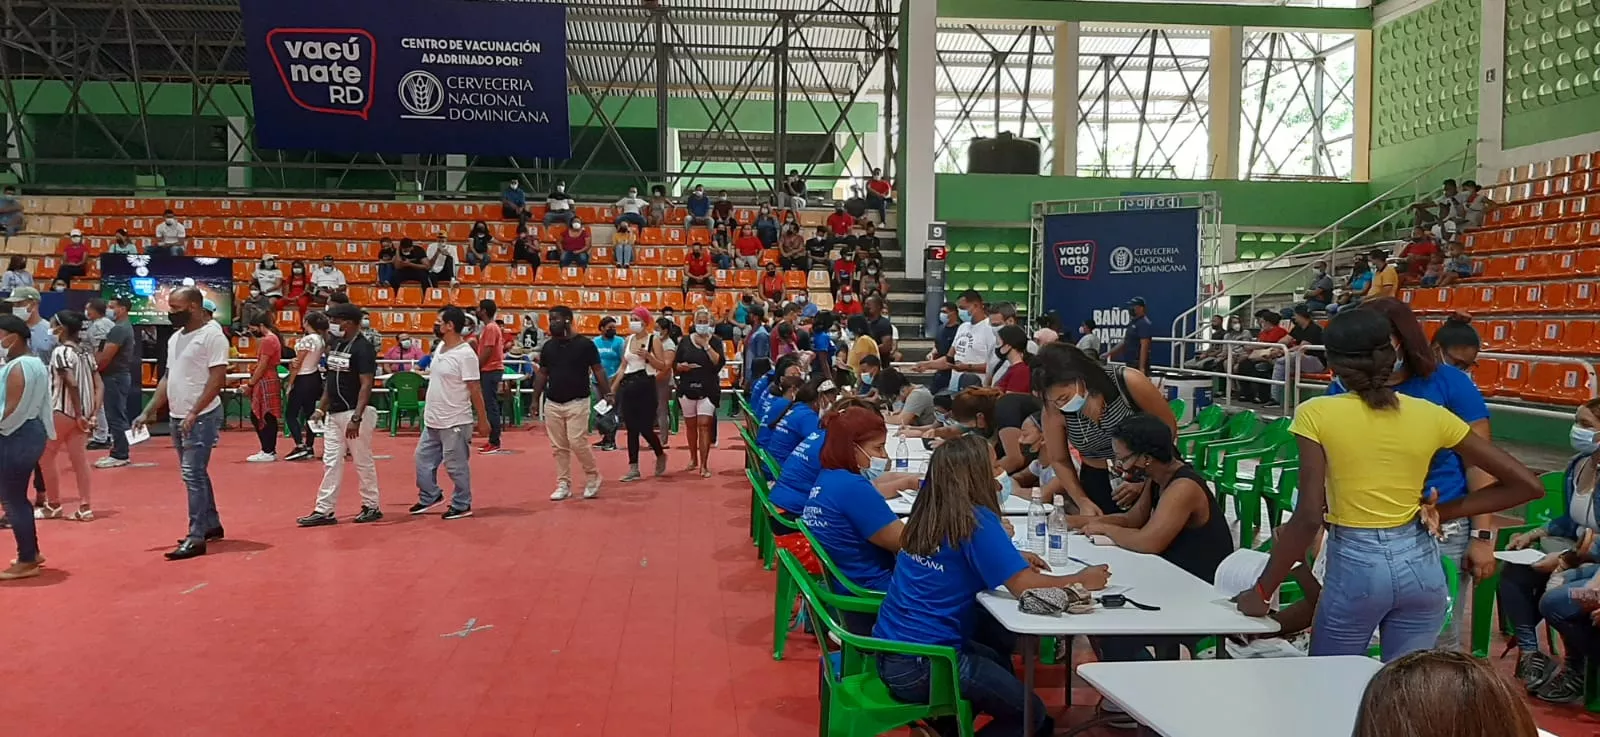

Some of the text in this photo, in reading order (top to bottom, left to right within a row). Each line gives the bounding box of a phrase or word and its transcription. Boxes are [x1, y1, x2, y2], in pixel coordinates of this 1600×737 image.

[284, 37, 360, 61] vacú
[401, 37, 541, 53] CENTRO DE VACUNACIÓN
[421, 53, 523, 67] APADRINADO POR:
[291, 63, 362, 84] nate
[446, 76, 534, 91] CERVECERIA
[329, 85, 364, 105] RD
[448, 92, 526, 107] NACIONAL
[449, 108, 549, 123] DOMINICANA
[933, 227, 942, 238] 9
[935, 249, 944, 259] 2
[1059, 243, 1090, 256] vacú
[1134, 247, 1180, 256] CERVECERIA
[1060, 257, 1089, 266] nate
[1134, 256, 1174, 264] NACIONAL
[1074, 265, 1089, 274] RD
[1134, 264, 1187, 273] DOMINICANA
